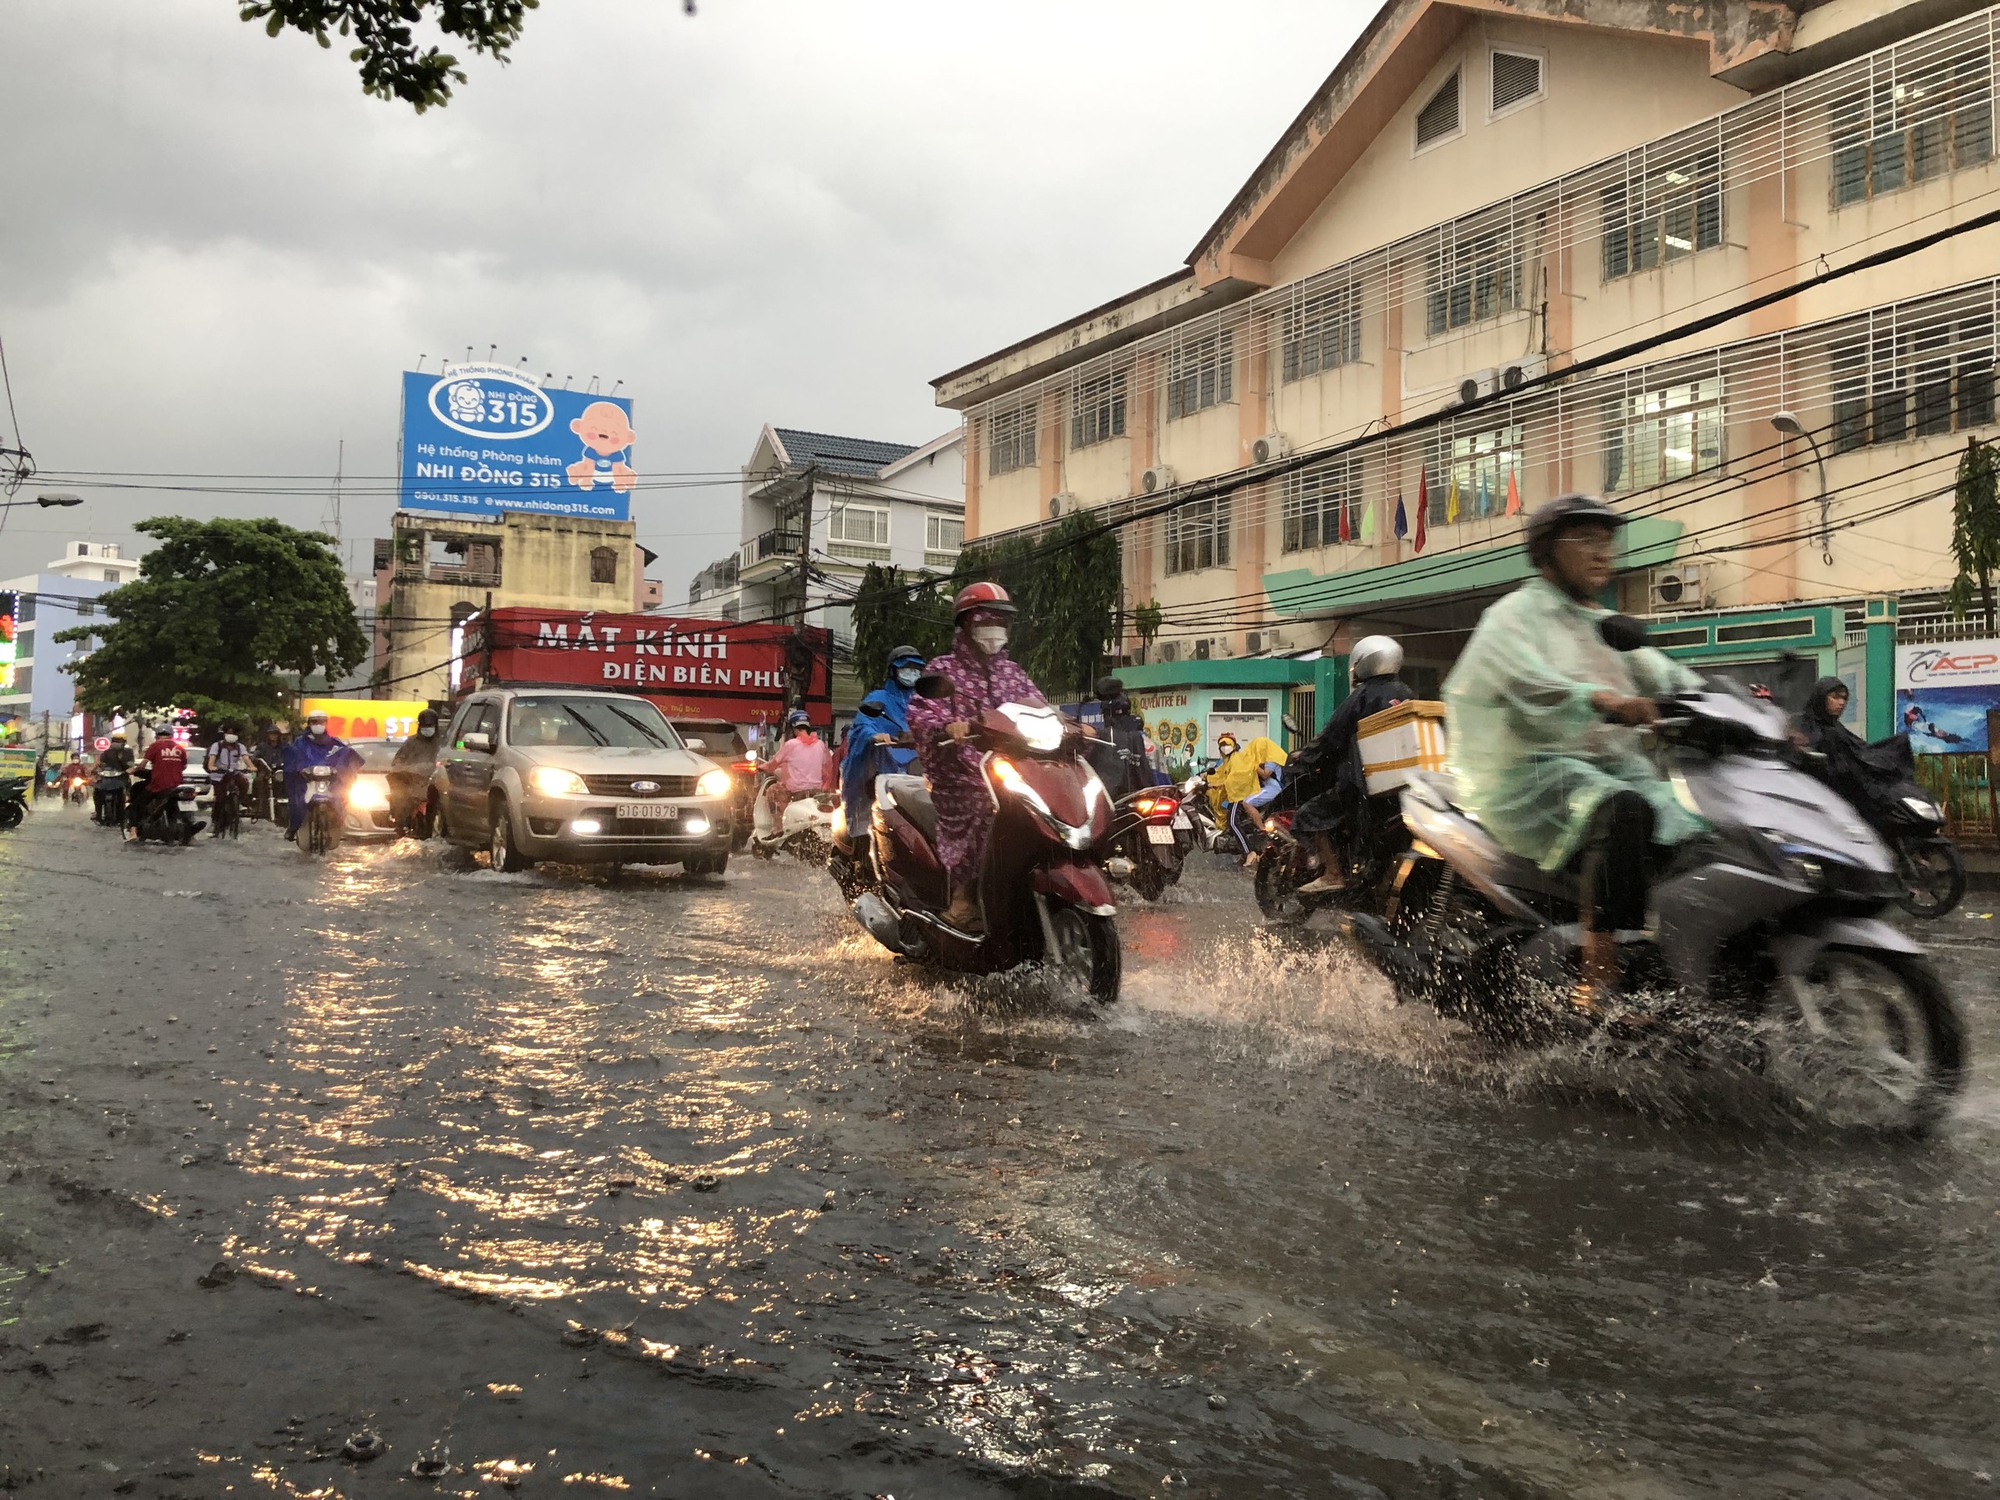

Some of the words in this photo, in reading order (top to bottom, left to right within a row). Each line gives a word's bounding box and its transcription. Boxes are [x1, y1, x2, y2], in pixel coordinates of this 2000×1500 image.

[447, 369, 458, 378] HỆ
[487, 368, 514, 378] PHÒNG
[488, 391, 506, 400] NHI
[488, 399, 538, 427] 315
[417, 443, 436, 457] Hệ
[439, 445, 479, 461] thống
[482, 449, 524, 465] Phòng
[527, 454, 562, 466] khám
[417, 462, 454, 478] NHI
[460, 461, 523, 486] ĐỒNG
[529, 472, 562, 488] 315
[536, 611, 622, 652] MẮT
[635, 623, 727, 659] KÍNH
[602, 658, 666, 687] ĐIỆN
[673, 662, 731, 685] BIÊN
[739, 665, 784, 688] PHỦ
[1931, 654, 1999, 671] ACP
[1176, 694, 1187, 706] EM
